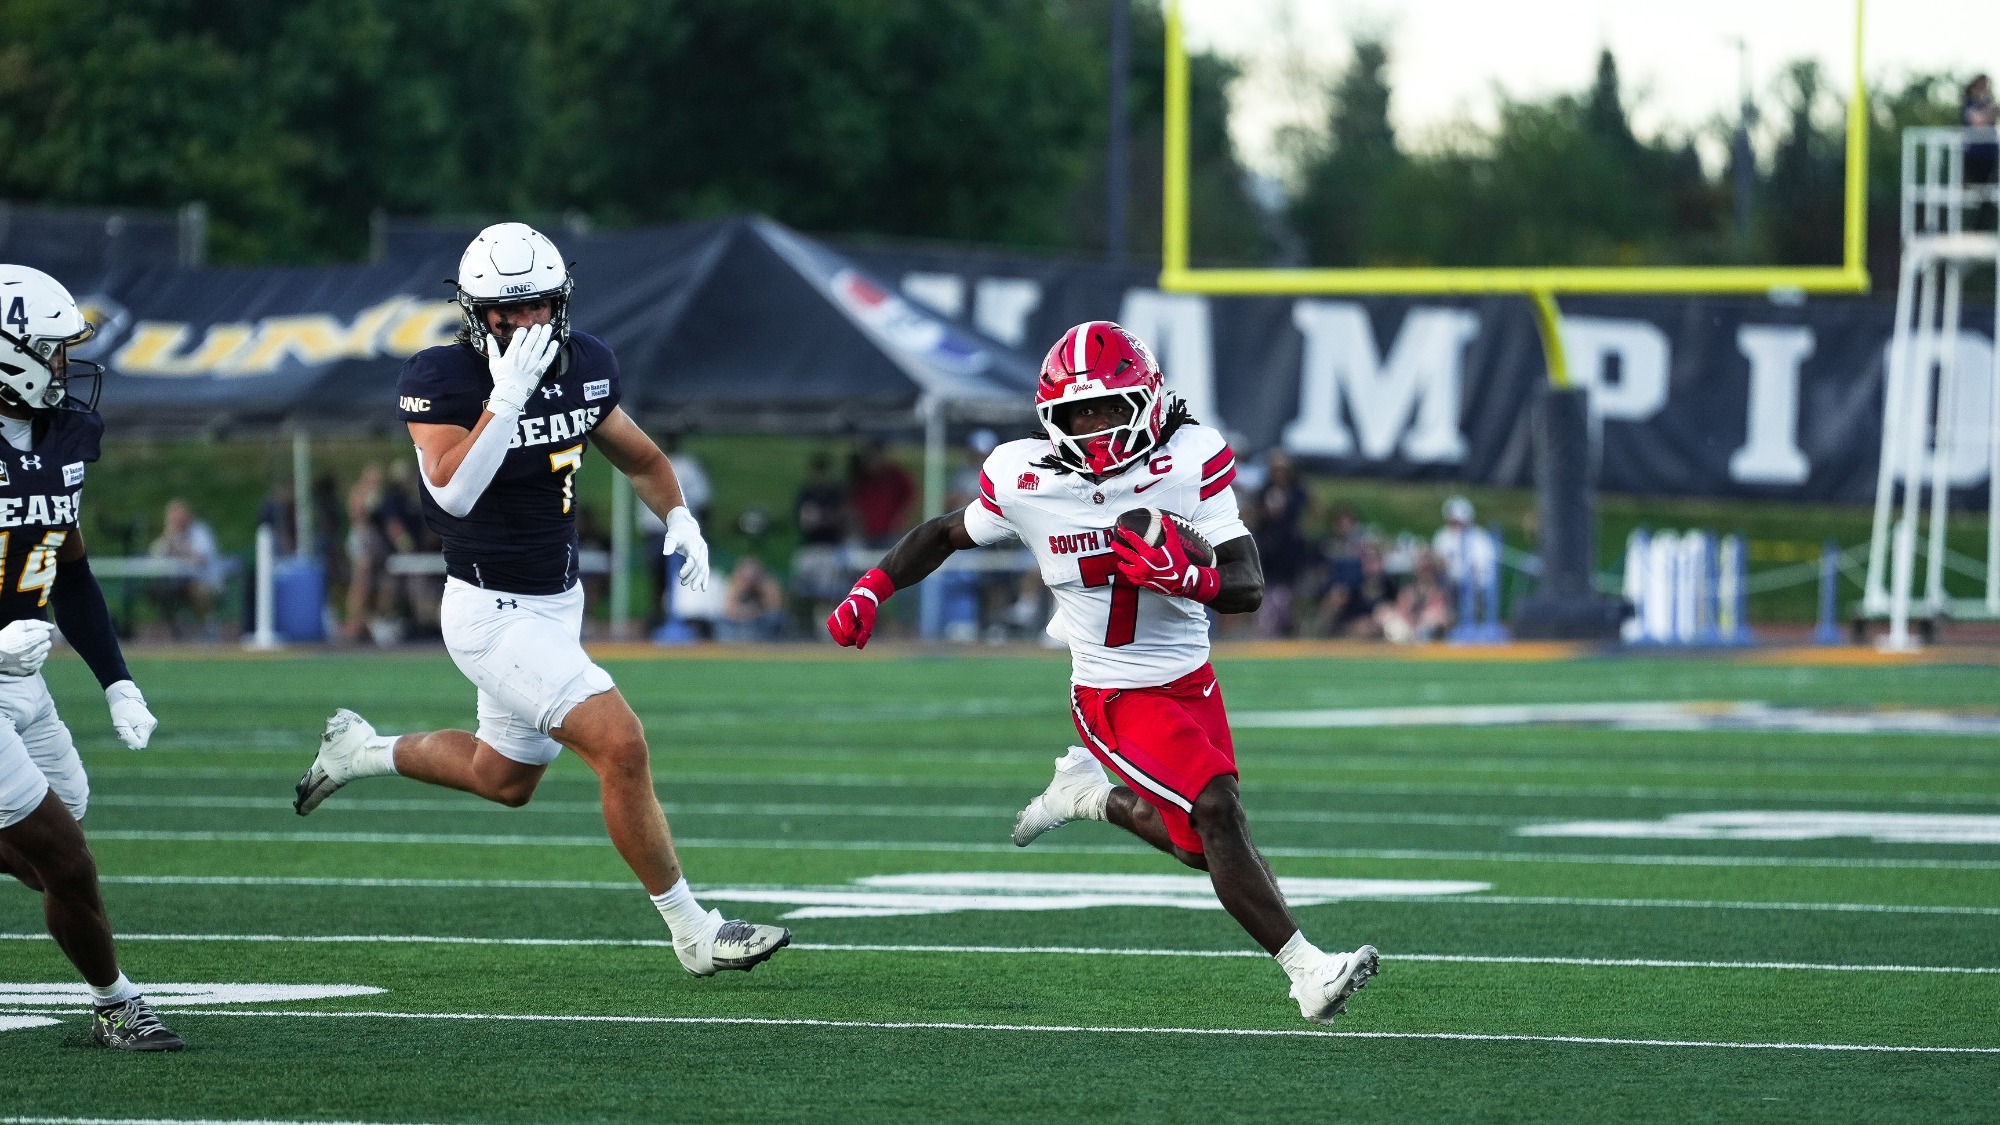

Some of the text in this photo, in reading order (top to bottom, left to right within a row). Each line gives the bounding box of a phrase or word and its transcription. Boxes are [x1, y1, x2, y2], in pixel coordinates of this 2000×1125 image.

[506, 284, 531, 294] UNC
[0, 296, 29, 334] 4
[113, 296, 463, 377] UNC
[1071, 383, 1094, 394] Yotes
[400, 395, 431, 413] UNC
[1149, 455, 1173, 475] C
[549, 443, 583, 514] 7
[1048, 531, 1100, 554] SOUTH
[1077, 550, 1140, 648] 7
